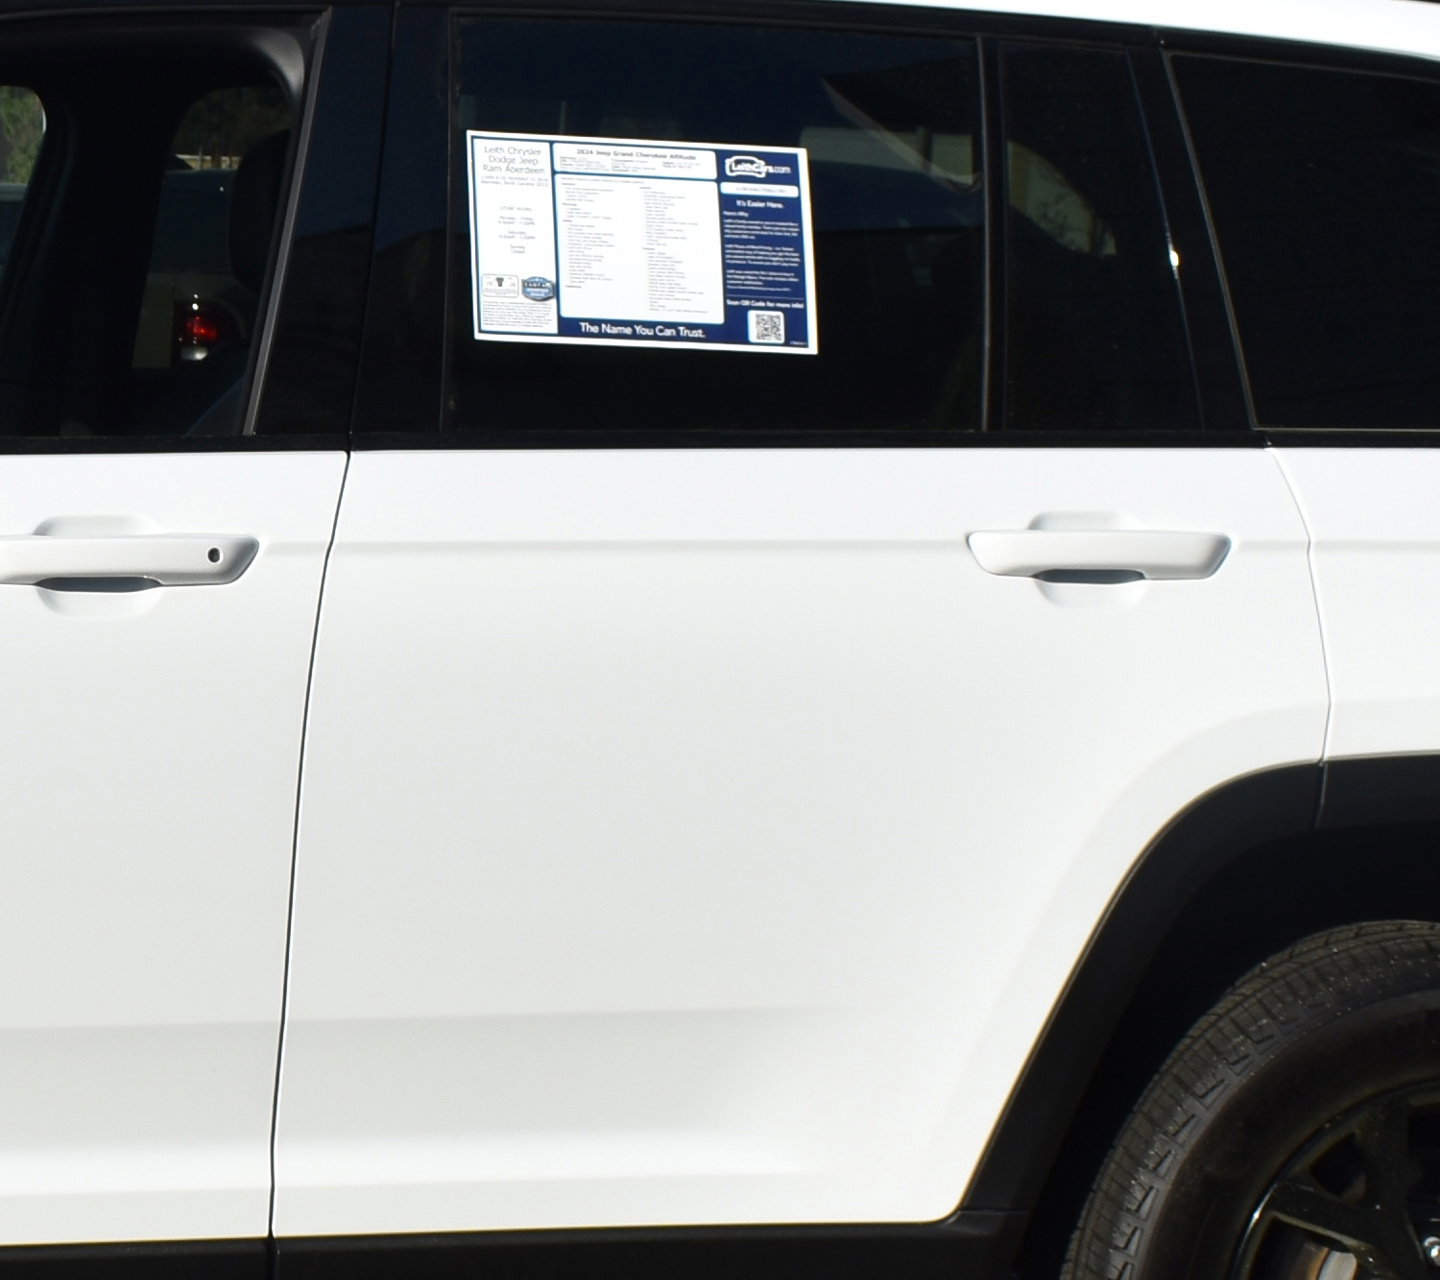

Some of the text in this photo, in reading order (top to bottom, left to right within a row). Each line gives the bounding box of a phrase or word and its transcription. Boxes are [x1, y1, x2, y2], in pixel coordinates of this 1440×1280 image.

[580, 322, 706, 338] The Name You Can Trust.
